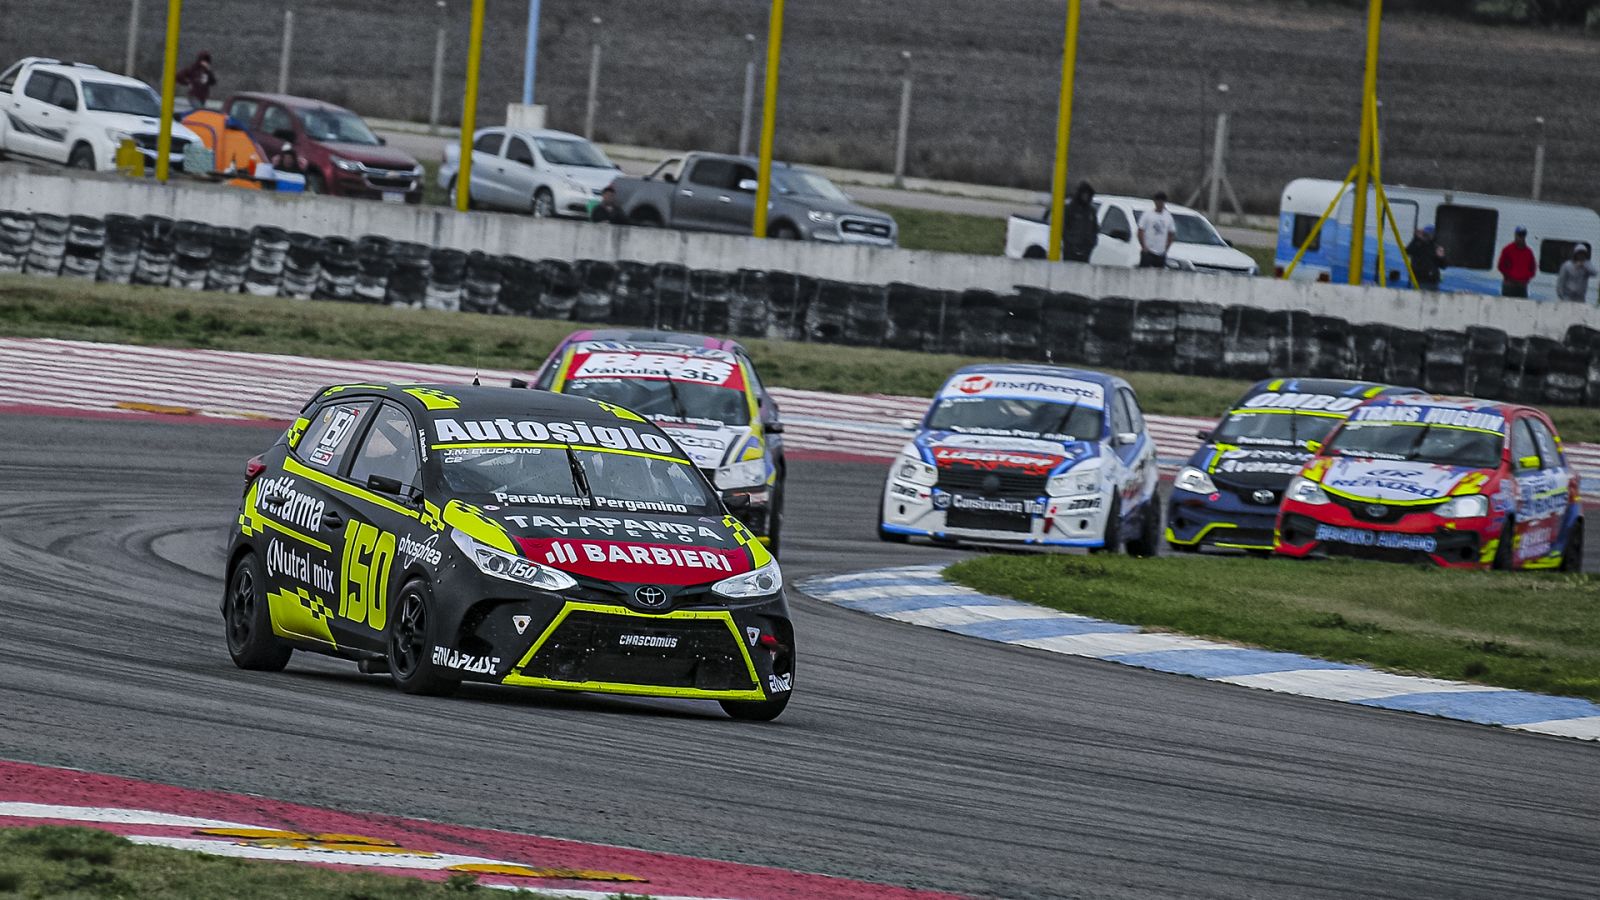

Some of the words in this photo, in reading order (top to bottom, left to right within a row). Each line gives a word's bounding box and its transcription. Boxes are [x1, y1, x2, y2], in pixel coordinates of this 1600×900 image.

[1356, 405, 1421, 422] TRANS
[434, 418, 673, 454] Autosiglo
[495, 493, 590, 506] Parabrisas
[596, 497, 687, 513] Pergamino
[504, 515, 724, 541] TALAPAMPA
[553, 528, 693, 543] VIVERO
[397, 533, 442, 570] phosphea
[582, 543, 732, 572] BARBIERI
[273, 539, 310, 584] Nutral
[313, 559, 335, 594] mix
[338, 518, 396, 631] 150
[511, 562, 539, 580] 150
[619, 634, 678, 648] CHASCOMUS
